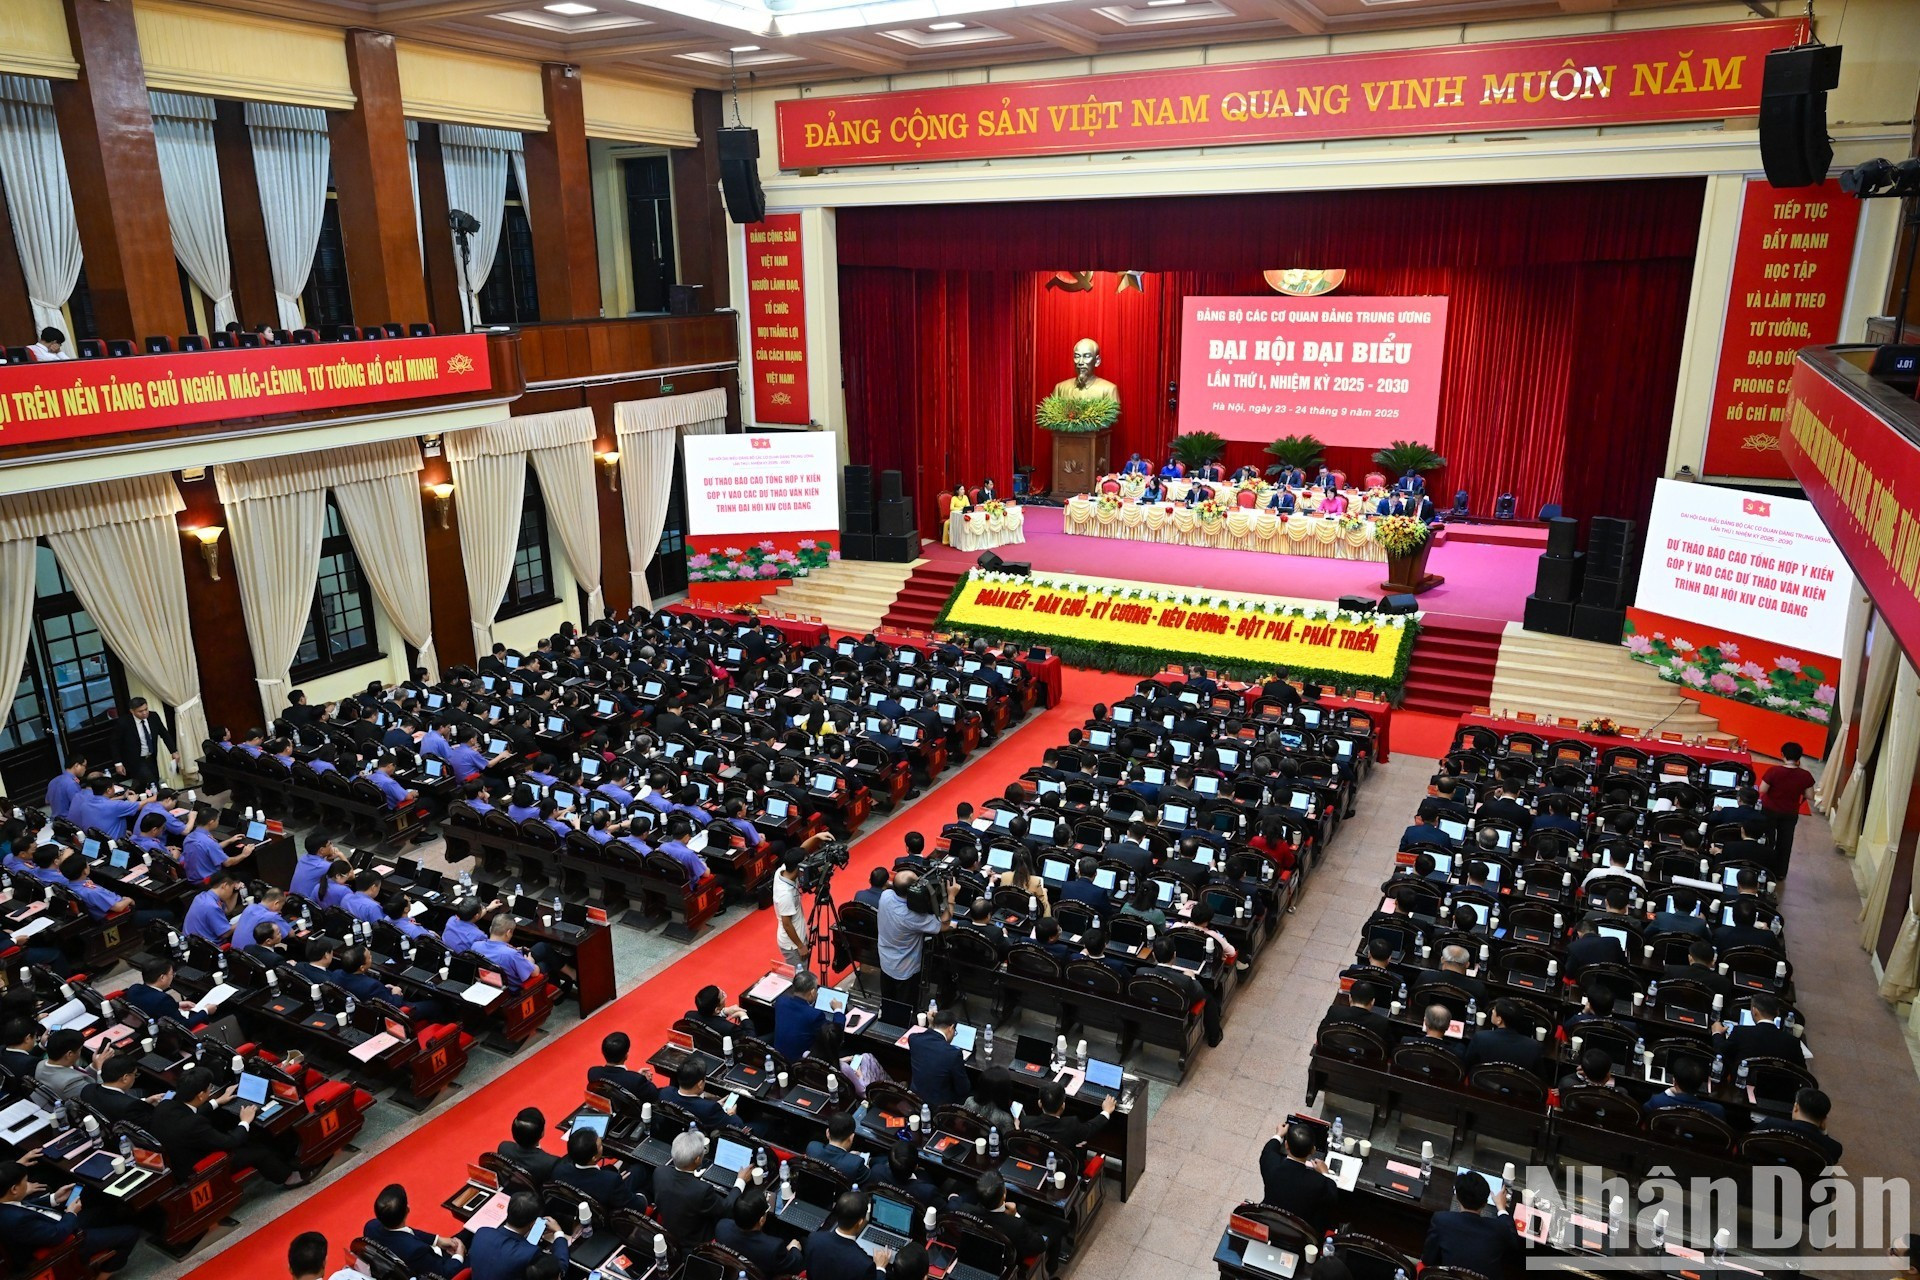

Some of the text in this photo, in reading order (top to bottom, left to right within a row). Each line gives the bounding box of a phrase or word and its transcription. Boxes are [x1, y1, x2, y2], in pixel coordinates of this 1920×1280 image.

[805, 50, 1746, 148] ĐẢNG CỘNG SẢN VIỆT NAM QUANG VINH MUÔN NĂM
[1773, 199, 1828, 221] TIẾP TỤC
[1762, 228, 1829, 251] ĐẨY MẠNH
[1764, 261, 1817, 281] HỌC TẬP
[1747, 292, 1826, 308] VÀ LÀM THEO
[1196, 308, 1431, 324] ĐẢNG BỘ CÁC CƠ QUAN ĐẢNG TRUNG ƯƠNG
[1750, 317, 1811, 339] TƯ TƯỞNG,
[1209, 332, 1412, 367] ĐẠI HỘI ĐẠI BIỂU
[1748, 351, 1772, 365] ĐẠO
[1897, 360, 1912, 368] J.01
[12, 384, 61, 421] TRÊN
[62, 378, 101, 416] NỀN
[101, 375, 145, 412] TẢNG
[147, 371, 179, 408] CHỦ
[181, 371, 227, 404] NGHĨA
[228, 365, 307, 400] MÁC-LÊNIN,
[307, 364, 324, 391] TƯ
[325, 357, 365, 389] TƯỞNG
[367, 354, 383, 385] HỒ
[385, 355, 404, 383] CHÍ
[406, 357, 438, 381] MINH!
[1207, 369, 1230, 387] LẦN
[1234, 372, 1257, 388] THỨ
[1270, 373, 1310, 393] NHIỆM
[1314, 373, 1330, 391] KỲ
[1333, 377, 1364, 392] 2025
[1376, 378, 1409, 393] 2030
[1733, 377, 1792, 394] PHONG CÁ
[1212, 402, 1225, 411] Hà
[1227, 403, 1245, 414] Nội,
[1249, 404, 1272, 415] ngày
[1275, 405, 1286, 413] 23
[1295, 406, 1306, 414] 24
[1309, 405, 1337, 418] tháng
[1341, 408, 1347, 416] 9
[1350, 408, 1371, 417] năm
[1375, 409, 1399, 418] 2025
[1727, 401, 1743, 420] HỒ
[1746, 404, 1767, 421] CHÍ
[1740, 592, 1756, 605] XIV
[108, 930, 117, 944] K
[434, 1052, 445, 1066] K
[325, 1116, 336, 1132] L
[195, 1186, 209, 1206] M
